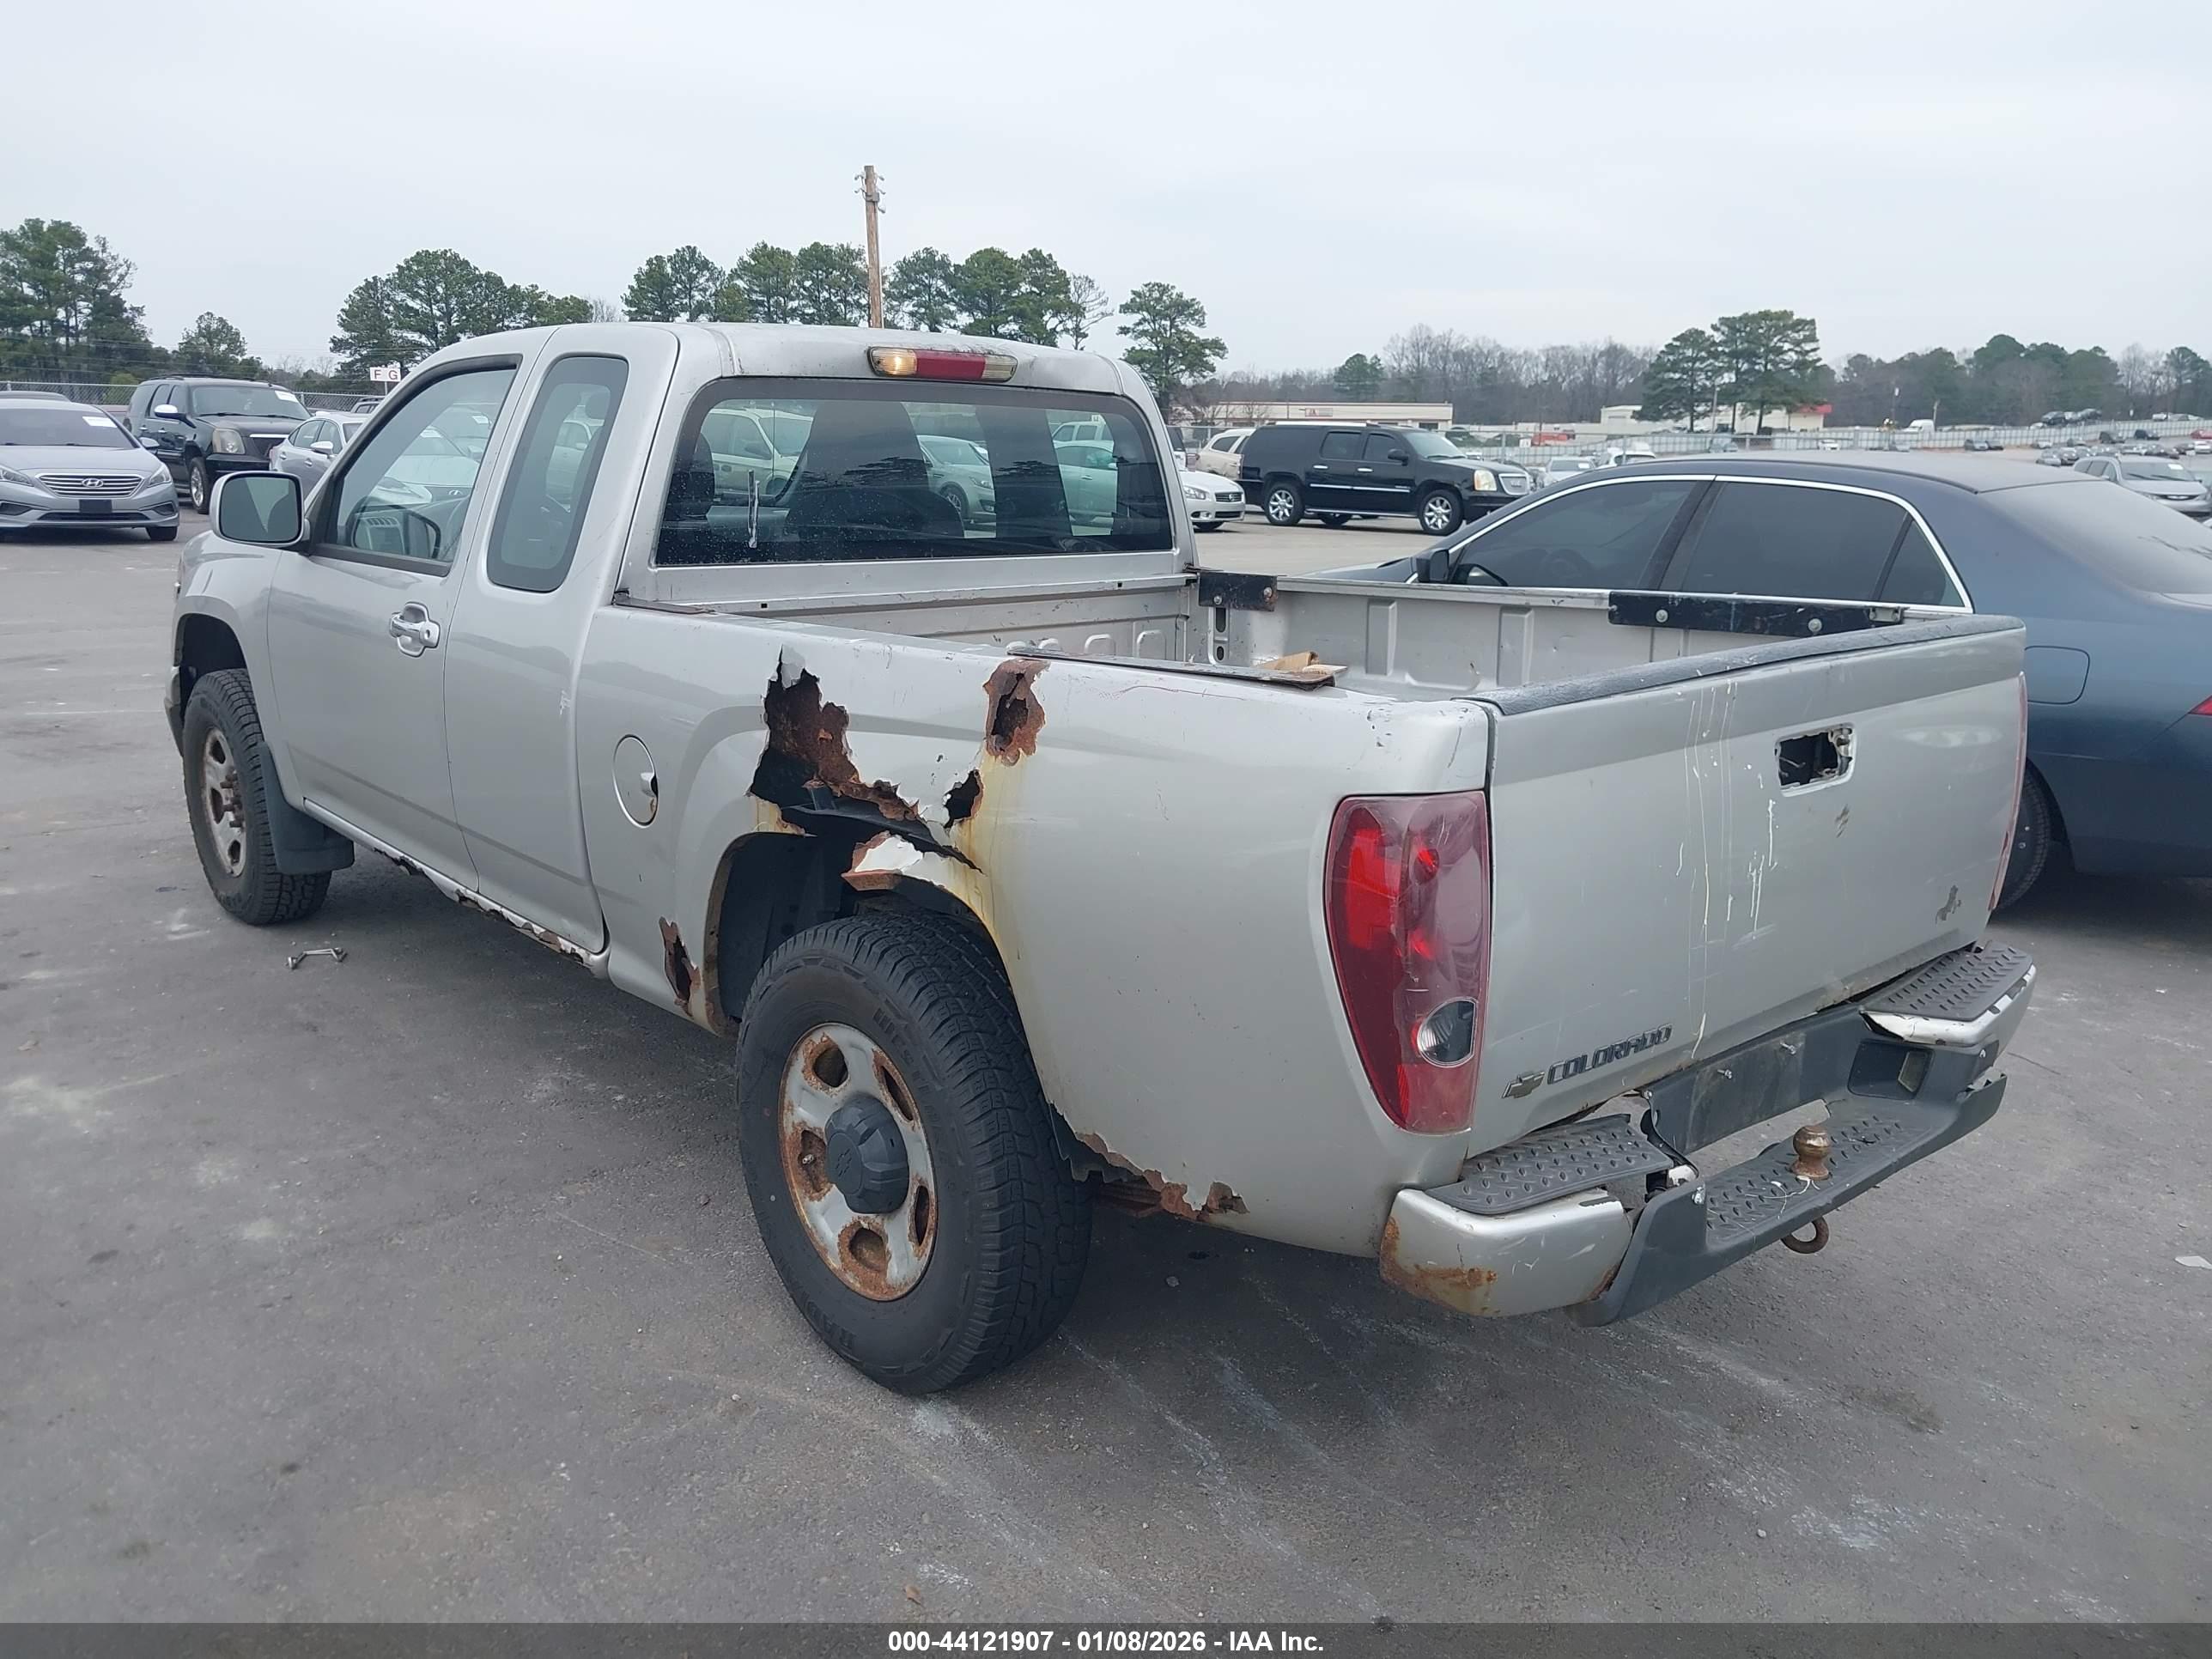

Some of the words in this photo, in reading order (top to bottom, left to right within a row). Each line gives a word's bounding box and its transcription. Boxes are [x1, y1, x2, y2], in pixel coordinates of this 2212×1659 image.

[374, 369, 382, 380] F
[388, 369, 398, 380] G
[1547, 1023, 1674, 1085] COLORADO
